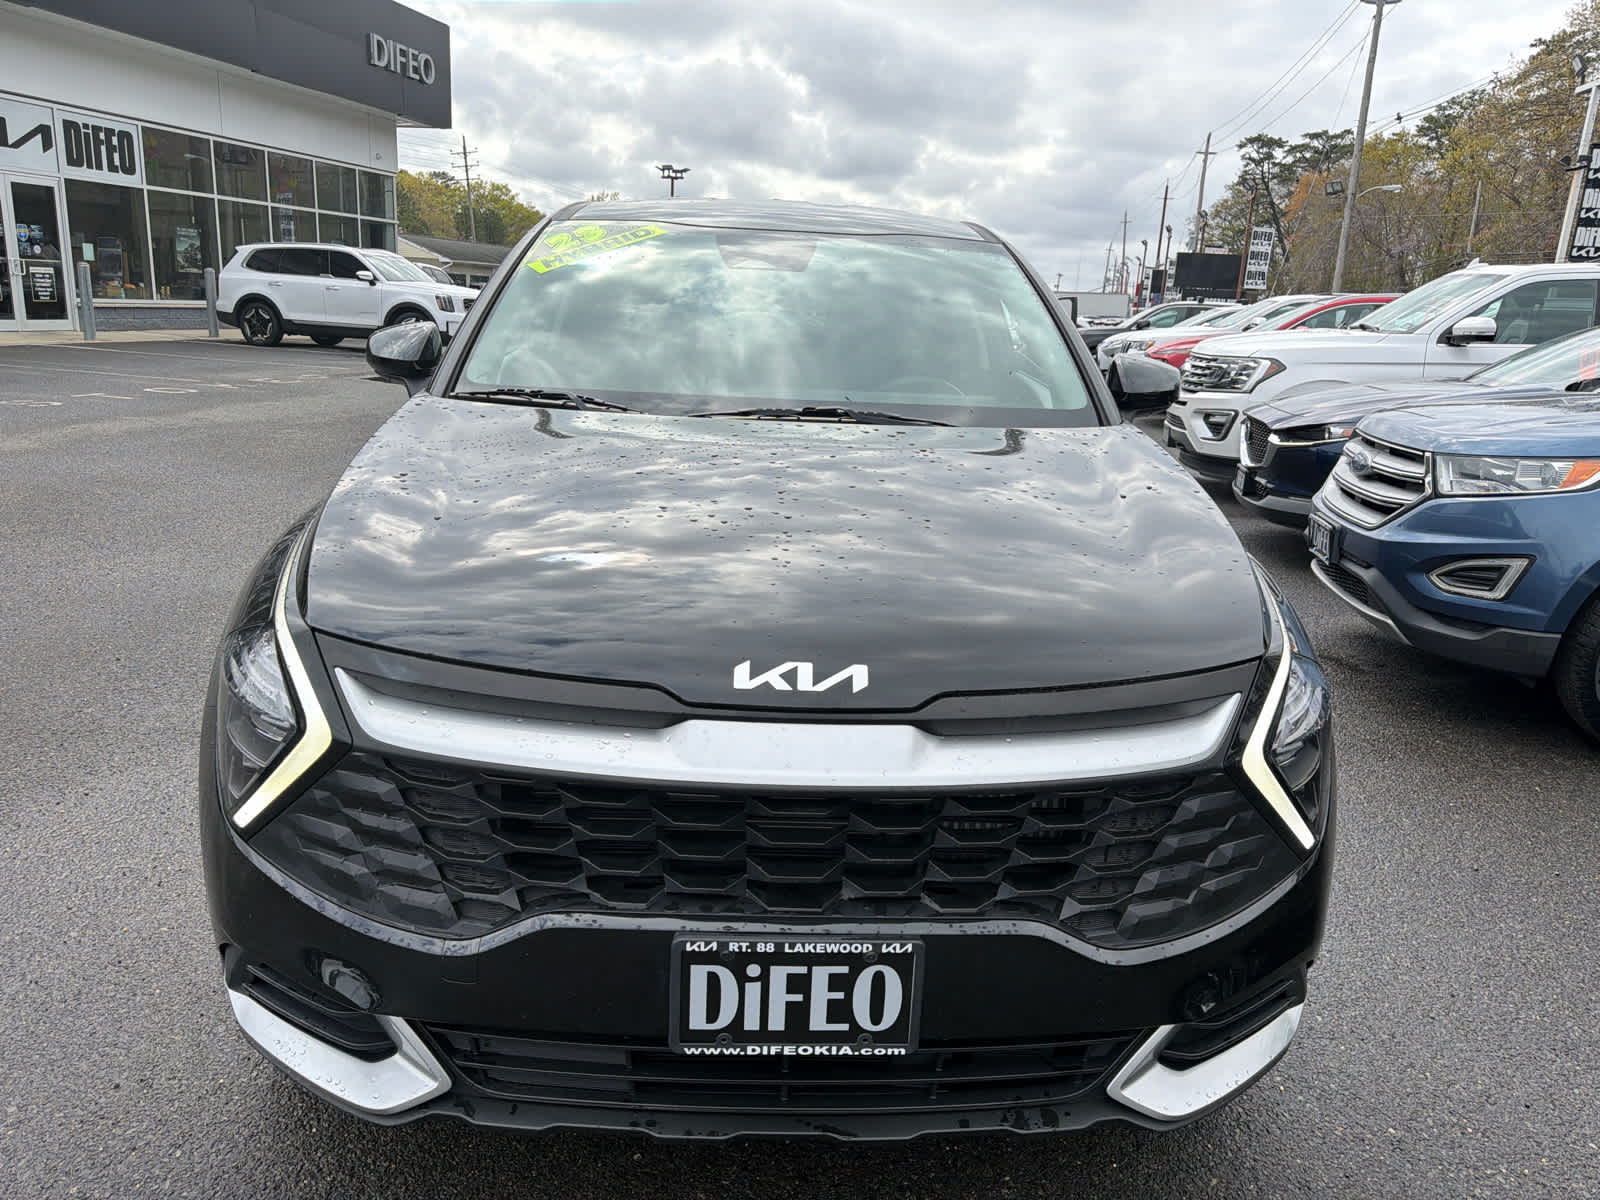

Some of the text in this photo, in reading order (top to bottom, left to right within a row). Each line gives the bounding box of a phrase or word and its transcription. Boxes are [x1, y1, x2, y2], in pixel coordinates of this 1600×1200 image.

[370, 32, 436, 86] DIFEO
[62, 118, 137, 176] DiFEO
[733, 660, 869, 694] KIA
[685, 941, 913, 954] KIA RT. 88 LAKEWOOD KIA
[688, 963, 903, 1032] DiFEO
[683, 1045, 906, 1056] www.DIFEOKIA.com
